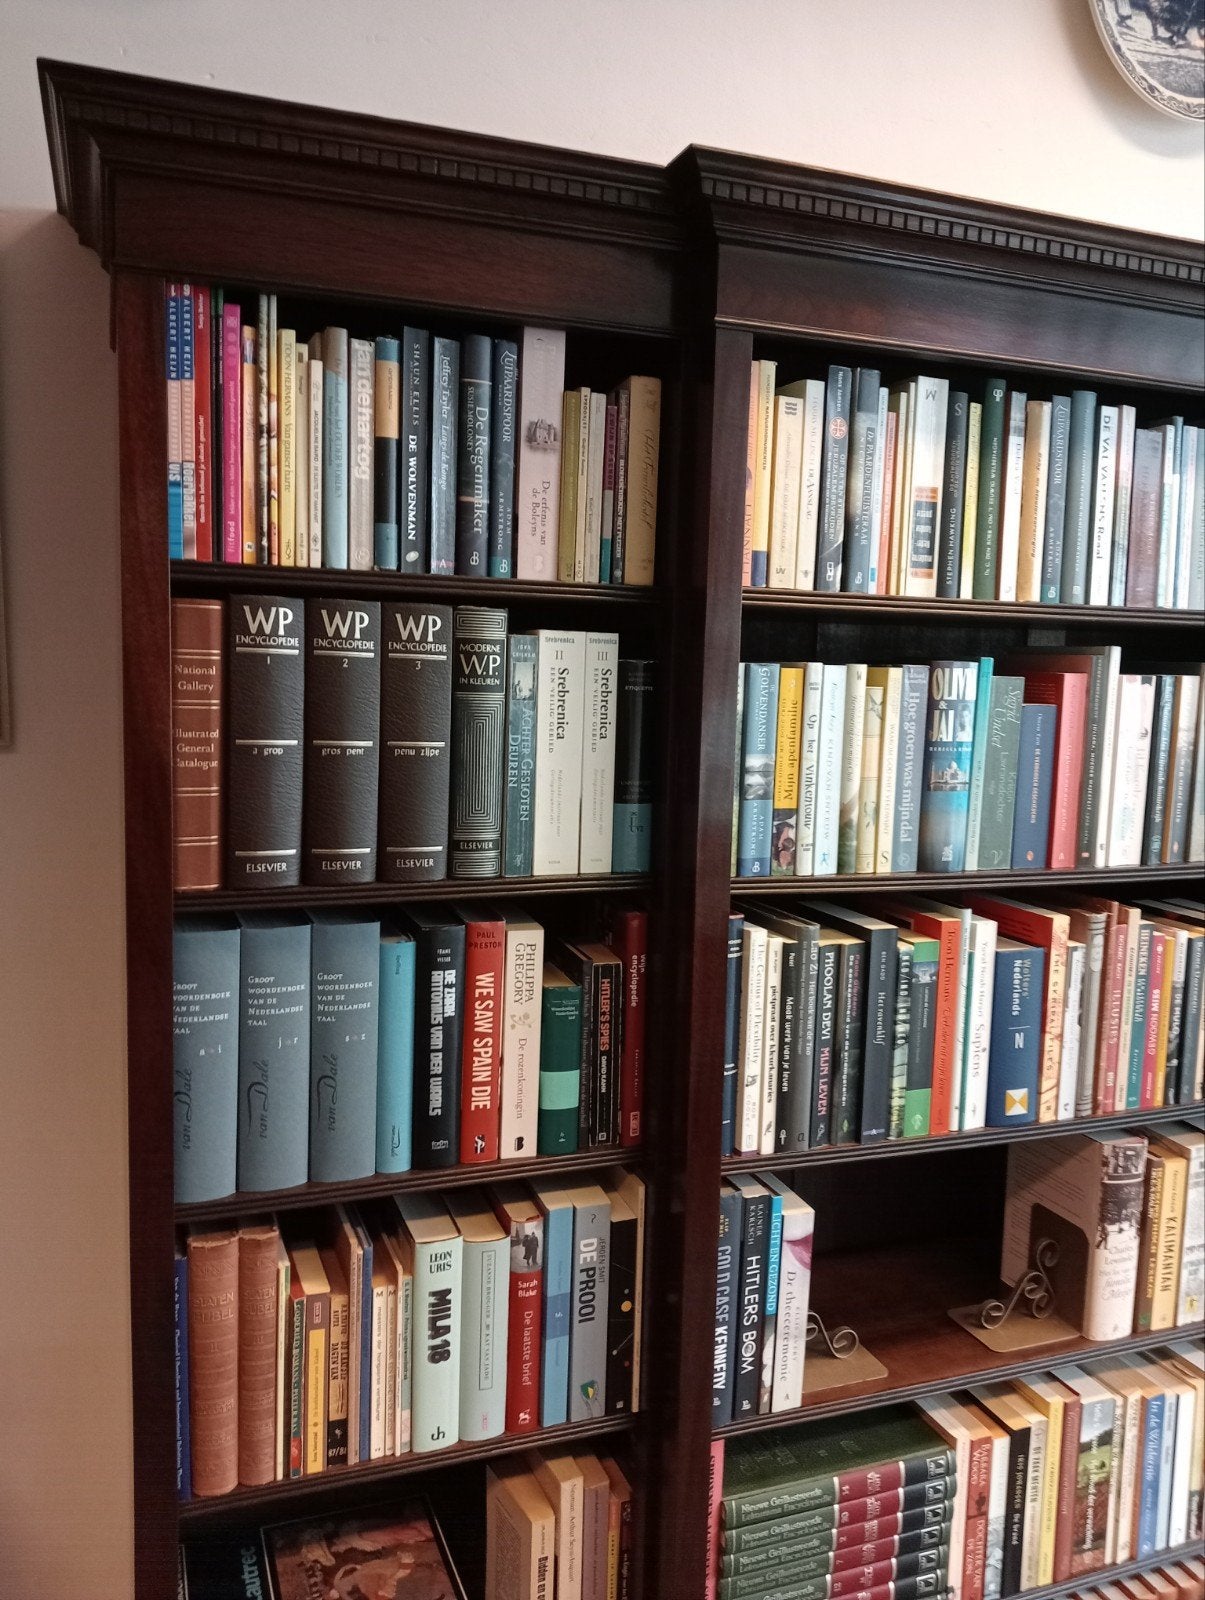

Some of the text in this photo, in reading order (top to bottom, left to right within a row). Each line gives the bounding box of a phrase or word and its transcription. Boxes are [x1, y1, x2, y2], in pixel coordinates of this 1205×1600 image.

[412, 343, 420, 426] SHAUN ELLIS
[502, 351, 516, 443] LUIPAARDSPOOR
[466, 410, 474, 452] MOLONEY
[1103, 415, 1111, 430] DE
[470, 406, 488, 534] De Regenmaker
[407, 435, 417, 540] DE WOLVENMAN
[528, 488, 540, 537] de Boleyns
[540, 480, 550, 546] De erfenis van
[948, 508, 956, 547] HAWKING
[243, 605, 293, 635] WP
[321, 609, 369, 639] WP
[395, 613, 442, 642] WP
[236, 635, 299, 646] ENCYCLOPEDIE
[314, 639, 374, 650] ENCYCLOPEDIE
[389, 642, 447, 652] ENCYCLOPEDIE
[459, 643, 501, 653] MODERNE
[545, 636, 575, 644] Srebrenica
[555, 650, 563, 660] II
[589, 637, 617, 645] Srebrenica
[175, 665, 216, 675] National
[342, 658, 348, 668] 2
[415, 660, 421, 670] 3
[597, 652, 608, 661] III
[178, 681, 214, 693] Gallery
[470, 677, 500, 685] KLEUREN
[556, 667, 570, 740] Srebrenica
[599, 668, 613, 740] Srebrenica
[756, 668, 770, 752] GOLVENDANSER
[939, 700, 948, 709] &
[1006, 687, 1020, 724] Sigrid
[991, 707, 1006, 749] Undset
[176, 744, 214, 753] General
[508, 735, 521, 787] DEUREN
[519, 708, 534, 821] ACHTER GESLOTEN
[899, 692, 920, 842] Hoe groen was mijn dal
[783, 773, 794, 801] Mijn
[750, 802, 759, 856] ARMSTRONG
[460, 841, 493, 850] ELSEVIER
[246, 863, 287, 873] ELSEVIER
[322, 860, 362, 870] ELSEVIER
[396, 858, 434, 868] ELSEVIER
[469, 942, 501, 950] PRESTON
[248, 976, 275, 984] GROOT
[317, 972, 343, 980] GROOT
[317, 981, 373, 991] WOORDENBOEK
[513, 942, 526, 1005] GREGORY
[524, 943, 537, 1003] PHILIPPA
[629, 955, 639, 1007] encyclopedie
[1011, 959, 1022, 1016] Nederlands
[248, 984, 306, 994] WOORDENBOEK
[248, 997, 265, 1005] VAN
[443, 969, 456, 1017] DE ZAAK
[600, 978, 610, 1021] HITLER'S
[248, 1005, 304, 1016] NEDERLANDSE
[317, 1002, 371, 1012] NEDERLANDSE
[428, 970, 443, 1116] ANTONIUS VAN DER WAALS
[471, 972, 495, 1111] WE SAW SPAIN DIE
[600, 1023, 609, 1051] SPIES
[782, 997, 794, 1092] Maak werk van je leven
[818, 952, 834, 1116] PHOOLAN DEVI MIJN LEVEN
[971, 1023, 986, 1078] Sapiens
[514, 1038, 528, 1119] De rozenkoningin
[747, 1205, 756, 1245] KARLSCH
[756, 1204, 764, 1236] RAINER
[429, 1262, 452, 1274] URIS
[430, 1251, 453, 1263] LEON
[766, 1211, 781, 1311] LICHT EN GEZOND
[518, 1279, 538, 1289] Sarah
[518, 1289, 537, 1298] Blake
[578, 1237, 598, 1324] DE PROOI
[787, 1271, 797, 1286] De
[427, 1287, 453, 1365] MILA 18
[740, 1256, 761, 1375] HITLERS BOM
[521, 1311, 534, 1386] De laatste brief
[537, 1556, 548, 1583] Bidden
